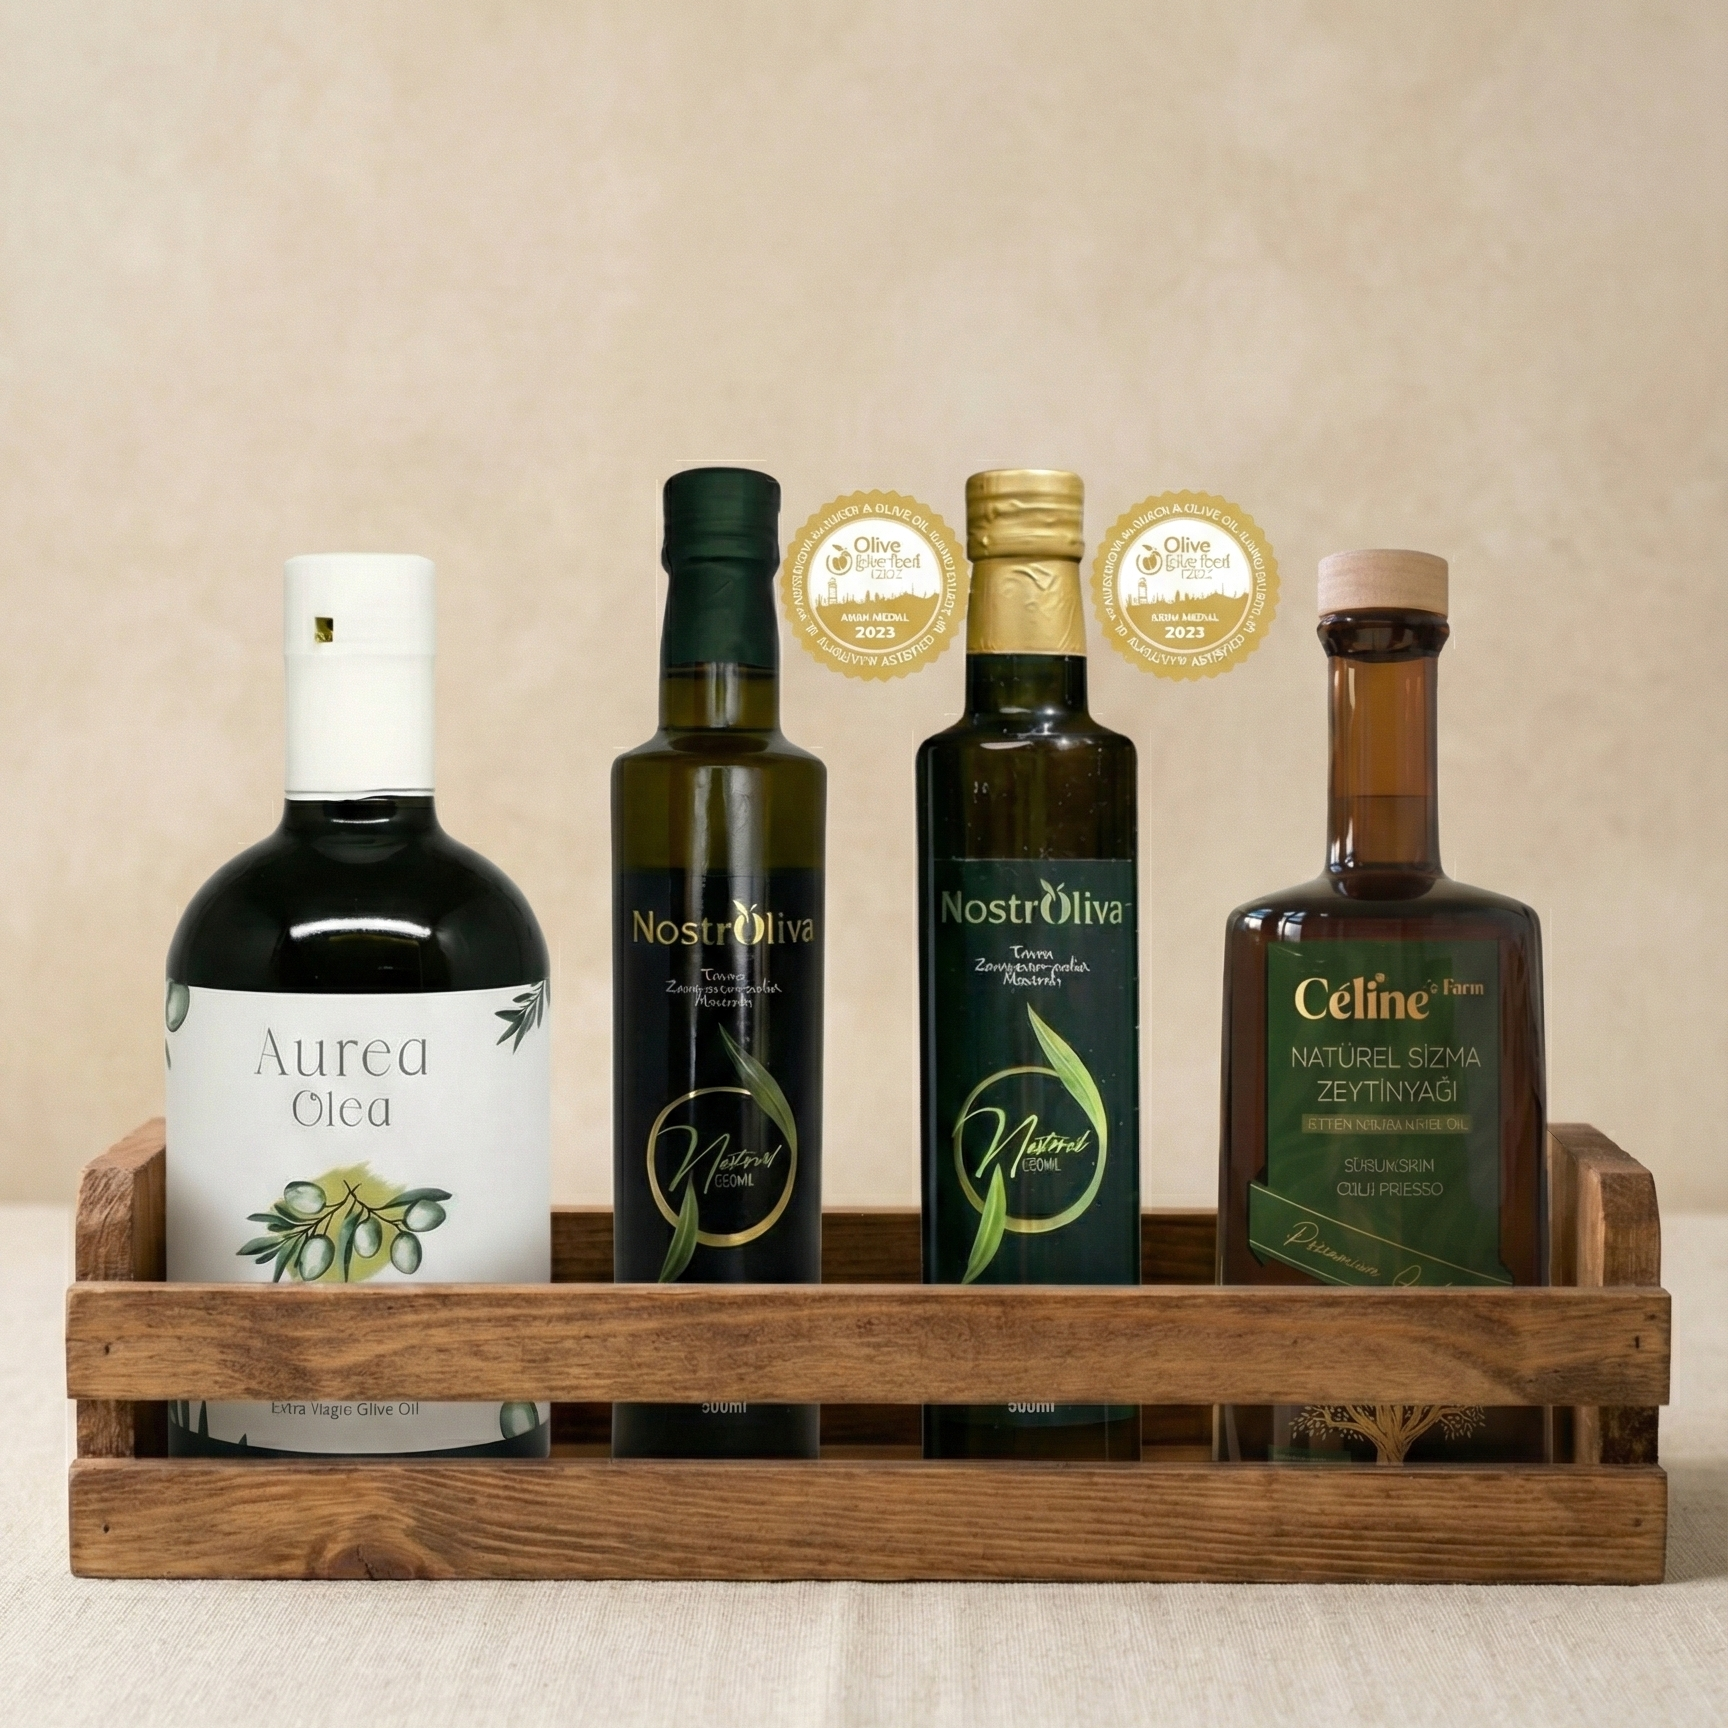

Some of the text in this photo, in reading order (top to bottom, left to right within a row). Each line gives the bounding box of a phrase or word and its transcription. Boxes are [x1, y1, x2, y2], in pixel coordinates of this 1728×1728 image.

[632, 901, 815, 946] NostrOliva
[941, 879, 1122, 924] NostrOliva
[1294, 972, 1485, 1020] Céline Farm
[254, 1027, 427, 1077] Aurea
[1291, 1042, 1481, 1068] NATÜREL SİZMA
[292, 1090, 390, 1127] Olea
[1317, 1076, 1457, 1102] ZEYTİNYAĞI
